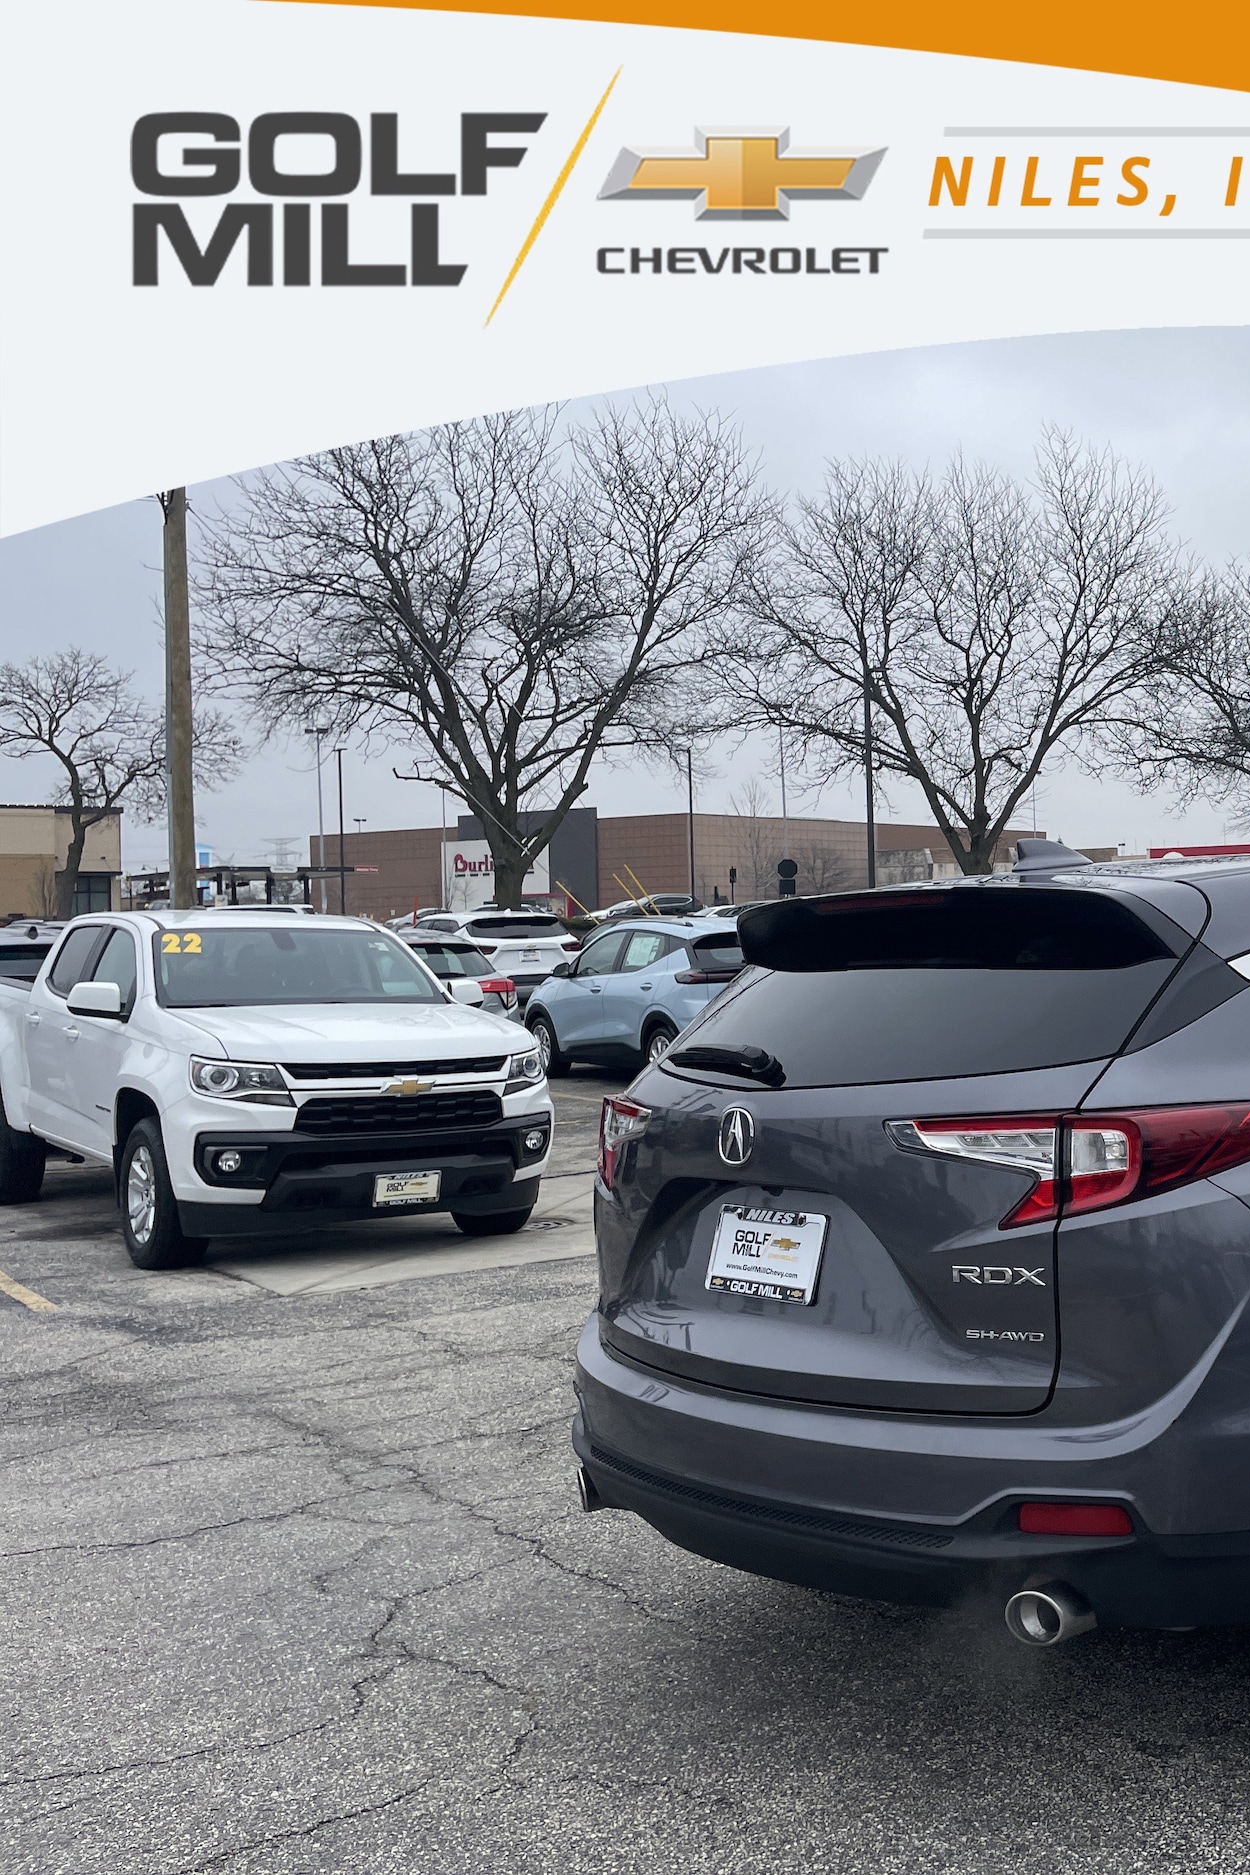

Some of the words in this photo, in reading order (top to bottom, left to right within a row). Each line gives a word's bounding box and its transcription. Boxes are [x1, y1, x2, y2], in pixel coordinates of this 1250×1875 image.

[162, 933, 202, 953] 22
[746, 1209, 796, 1225] NILES
[735, 1229, 772, 1245] GOLF
[732, 1243, 762, 1258] MILL
[726, 1262, 798, 1279] www.GolfMillChevy.com
[952, 1265, 1047, 1286] RDX
[730, 1280, 759, 1295] GOLF
[759, 1284, 783, 1299] MILL
[966, 1329, 1045, 1342] SH-AWD
